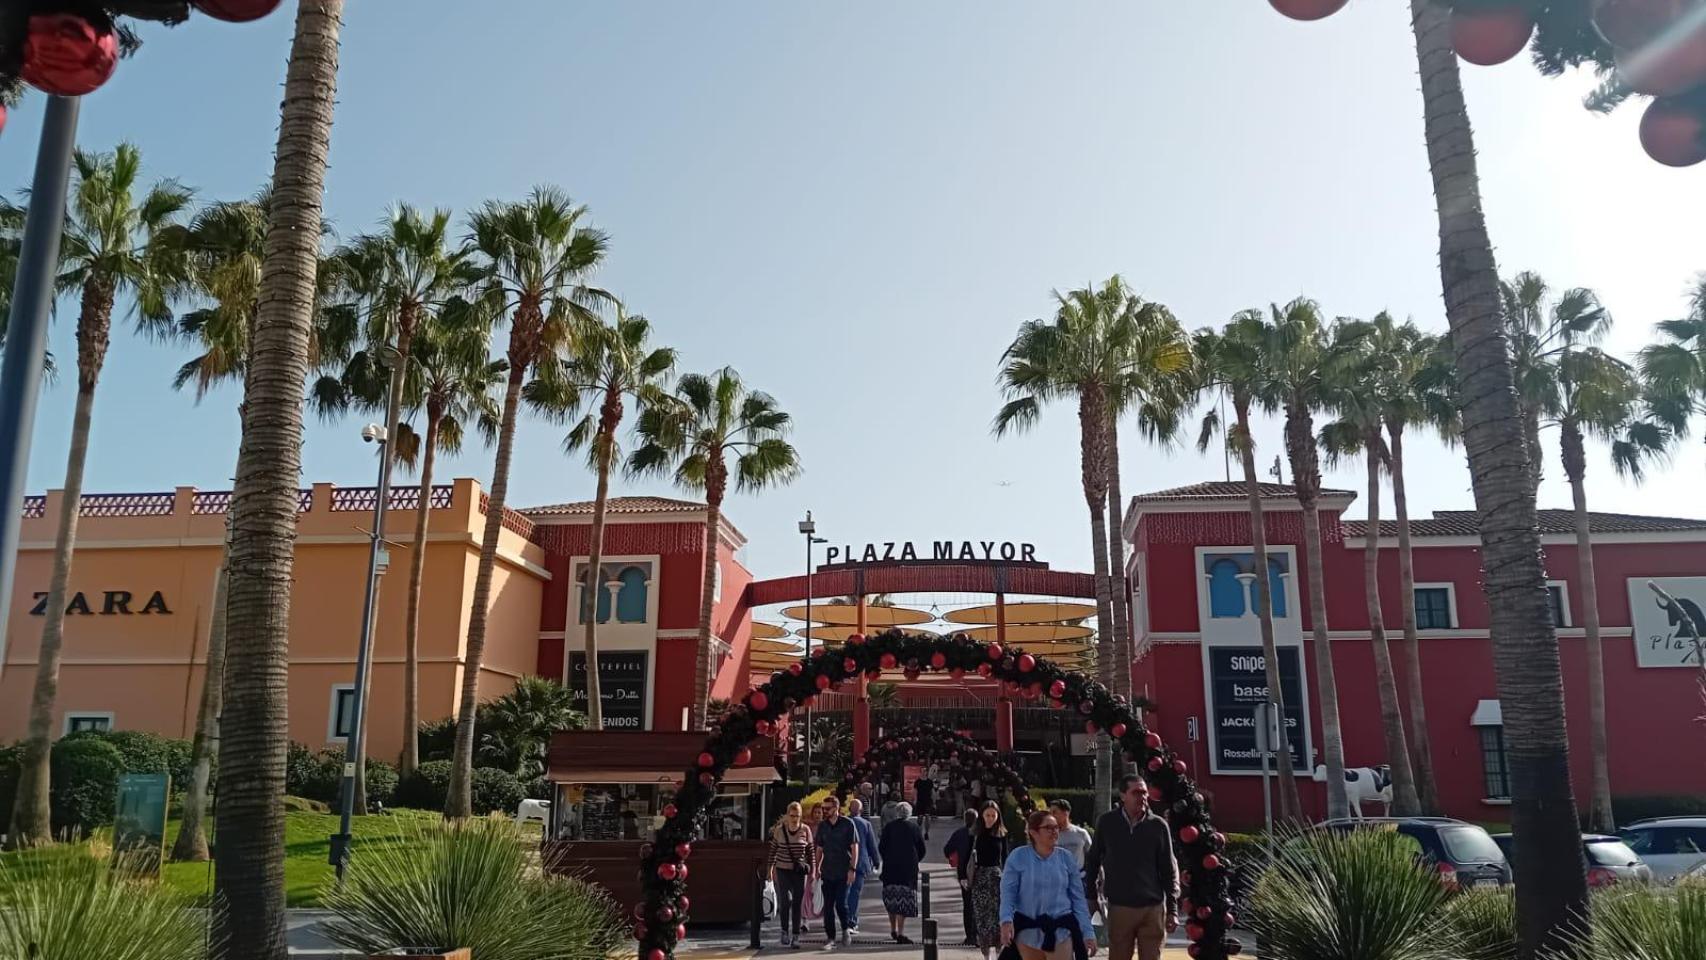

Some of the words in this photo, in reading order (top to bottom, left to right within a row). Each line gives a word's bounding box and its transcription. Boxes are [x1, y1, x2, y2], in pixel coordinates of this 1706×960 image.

[826, 541, 918, 564] PLAZA
[933, 541, 1036, 562] MAYOR
[29, 591, 174, 615] ZARA
[1231, 656, 1266, 673] snipe
[1233, 684, 1271, 697] base
